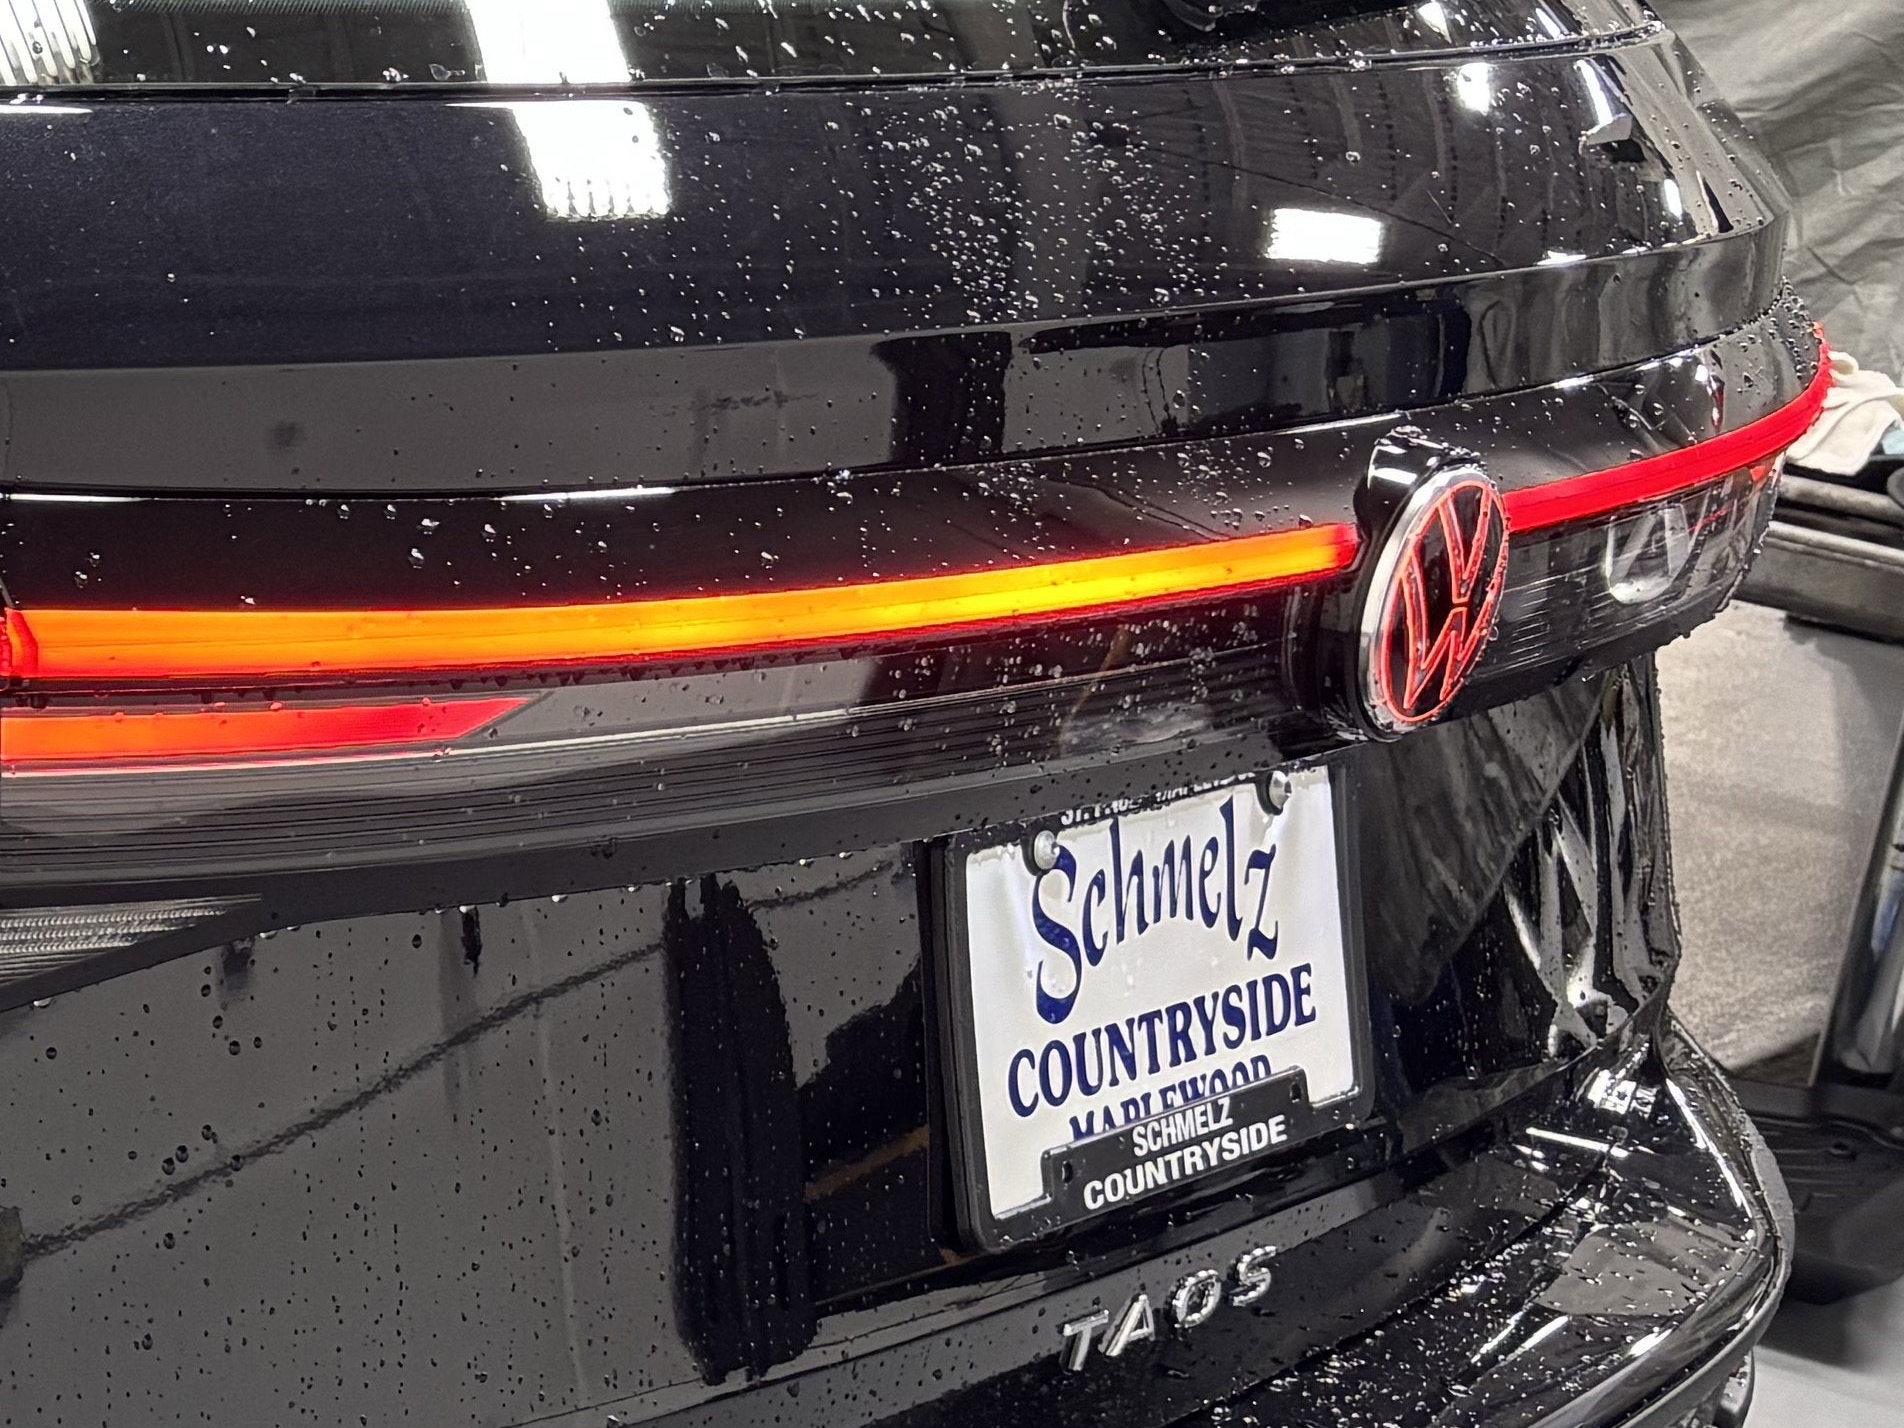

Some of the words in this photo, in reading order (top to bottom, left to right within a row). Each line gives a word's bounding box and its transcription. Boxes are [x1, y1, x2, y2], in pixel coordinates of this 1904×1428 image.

[1031, 794, 1280, 1025] Schmelz
[1007, 962, 1318, 1119] COUNTRYSIDE
[1082, 1113, 1289, 1211] COUNTRYSIDE
[1132, 1096, 1235, 1157] SCHMELZ
[1060, 1244, 1278, 1371] TAOS
